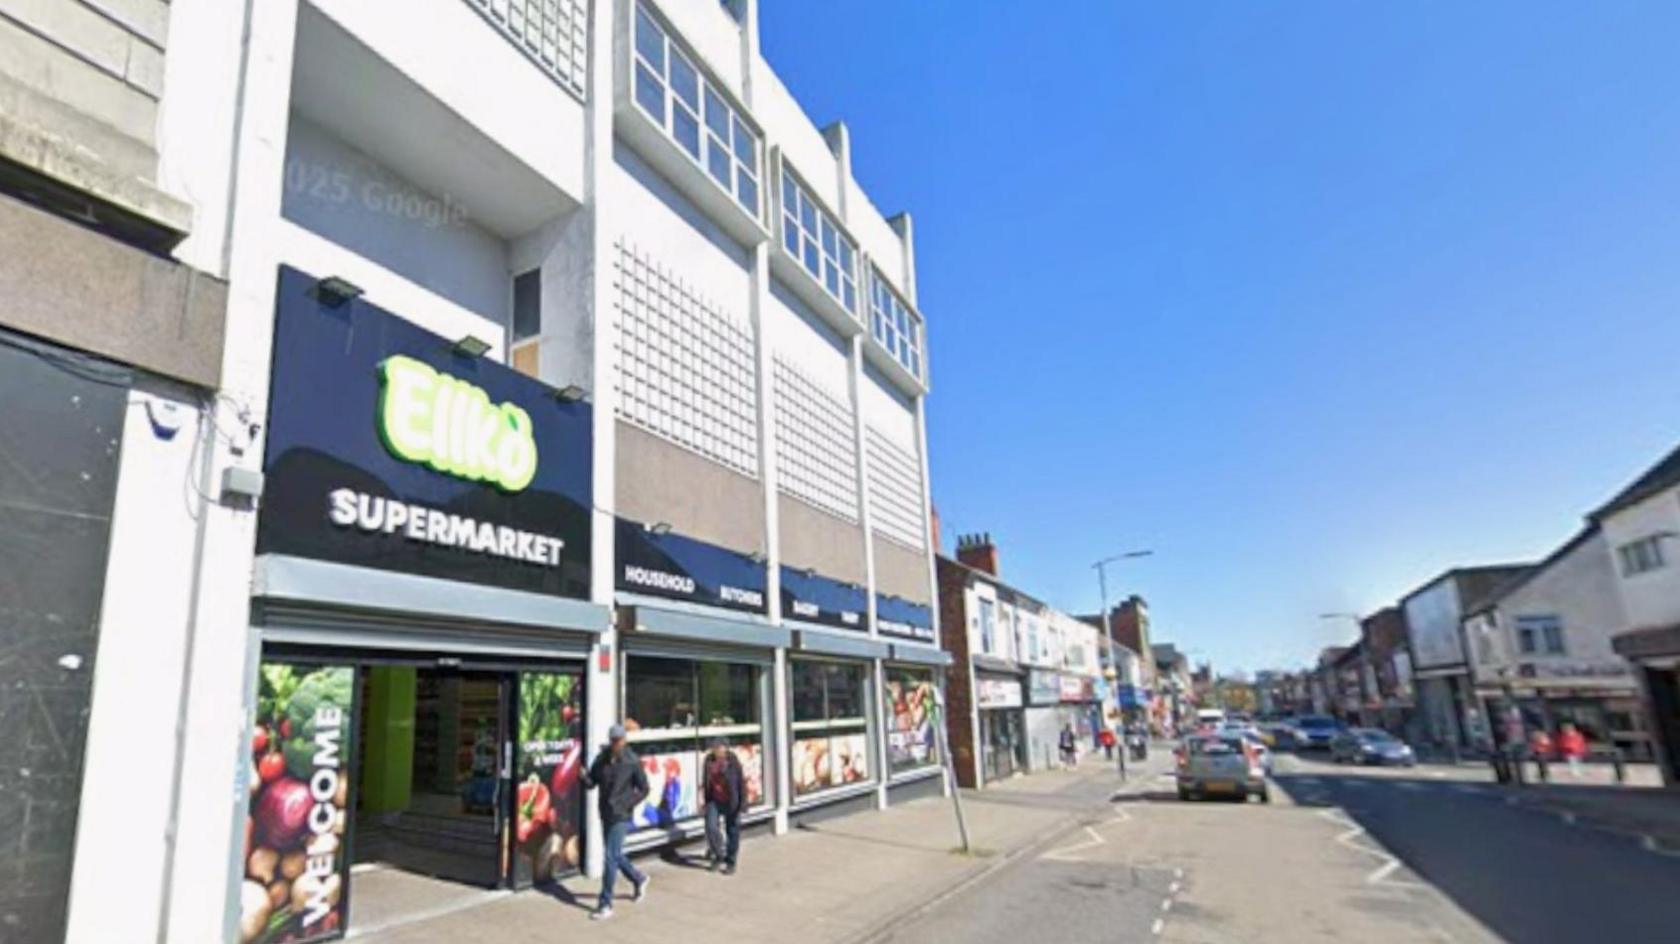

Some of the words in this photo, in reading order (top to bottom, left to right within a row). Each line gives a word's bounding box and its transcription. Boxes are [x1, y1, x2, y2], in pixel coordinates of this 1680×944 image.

[384, 361, 533, 489] Ellko
[330, 489, 564, 566] SUPERMARKET
[625, 565, 695, 593] HOUSEHOLD
[302, 706, 342, 927] WELCOME
